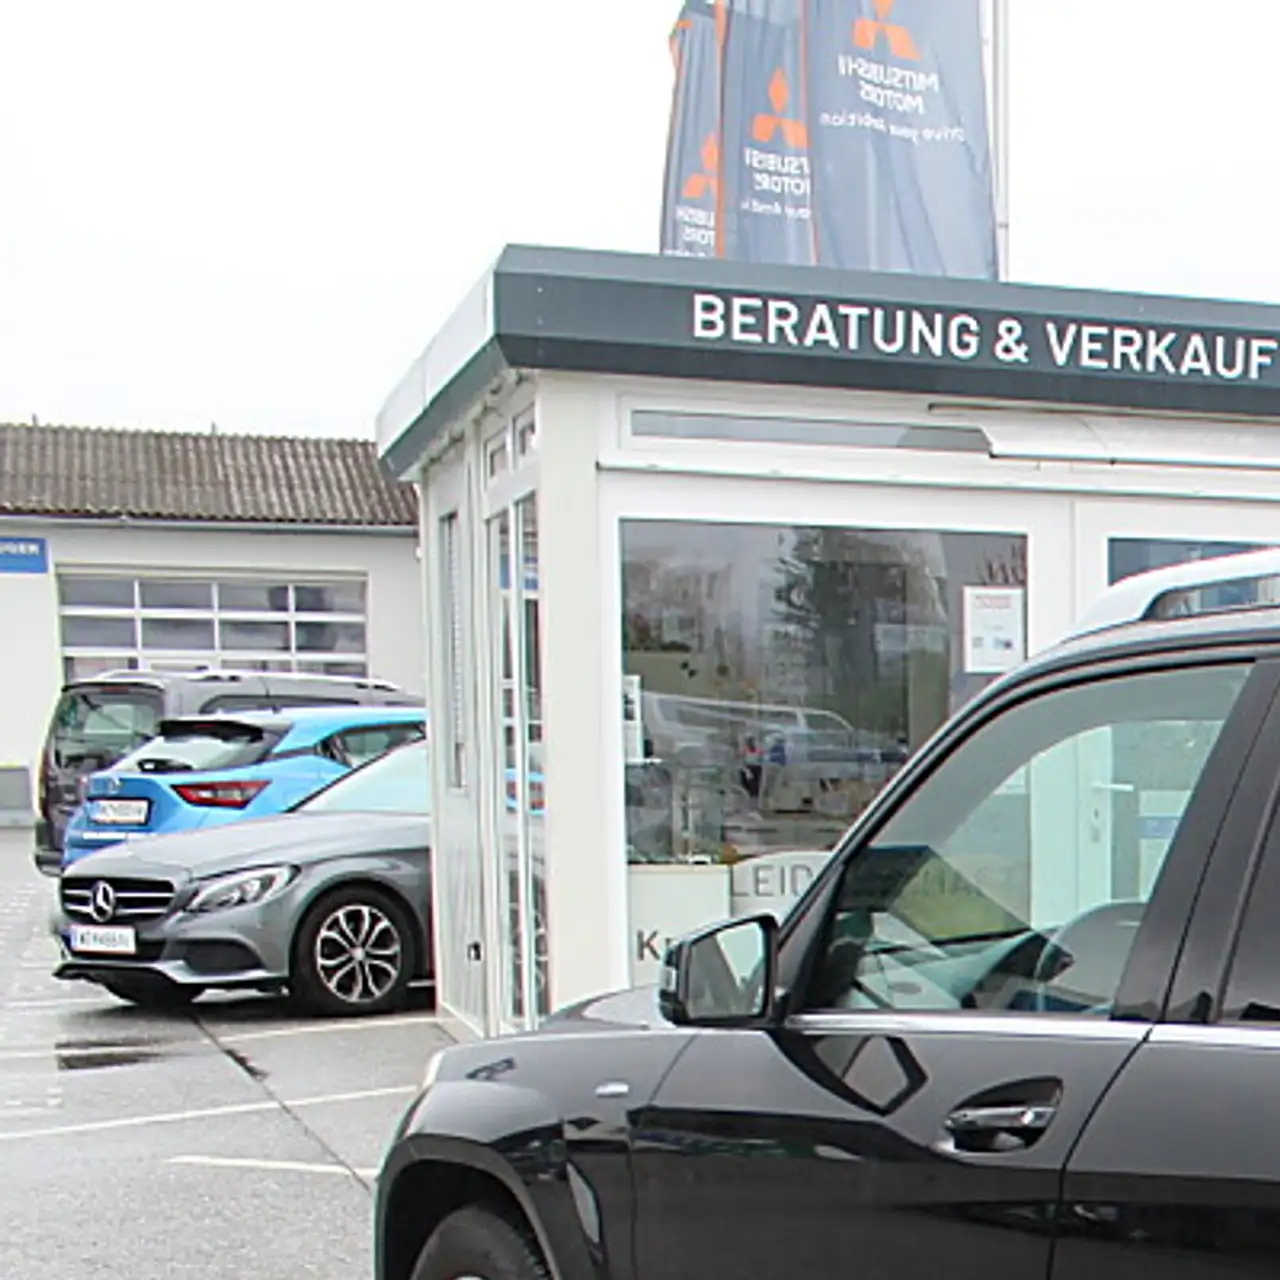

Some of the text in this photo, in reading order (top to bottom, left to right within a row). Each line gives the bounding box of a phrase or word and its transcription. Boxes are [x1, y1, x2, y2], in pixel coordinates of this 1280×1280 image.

[692, 293, 1279, 381] BERATUNG & VERKAUF
